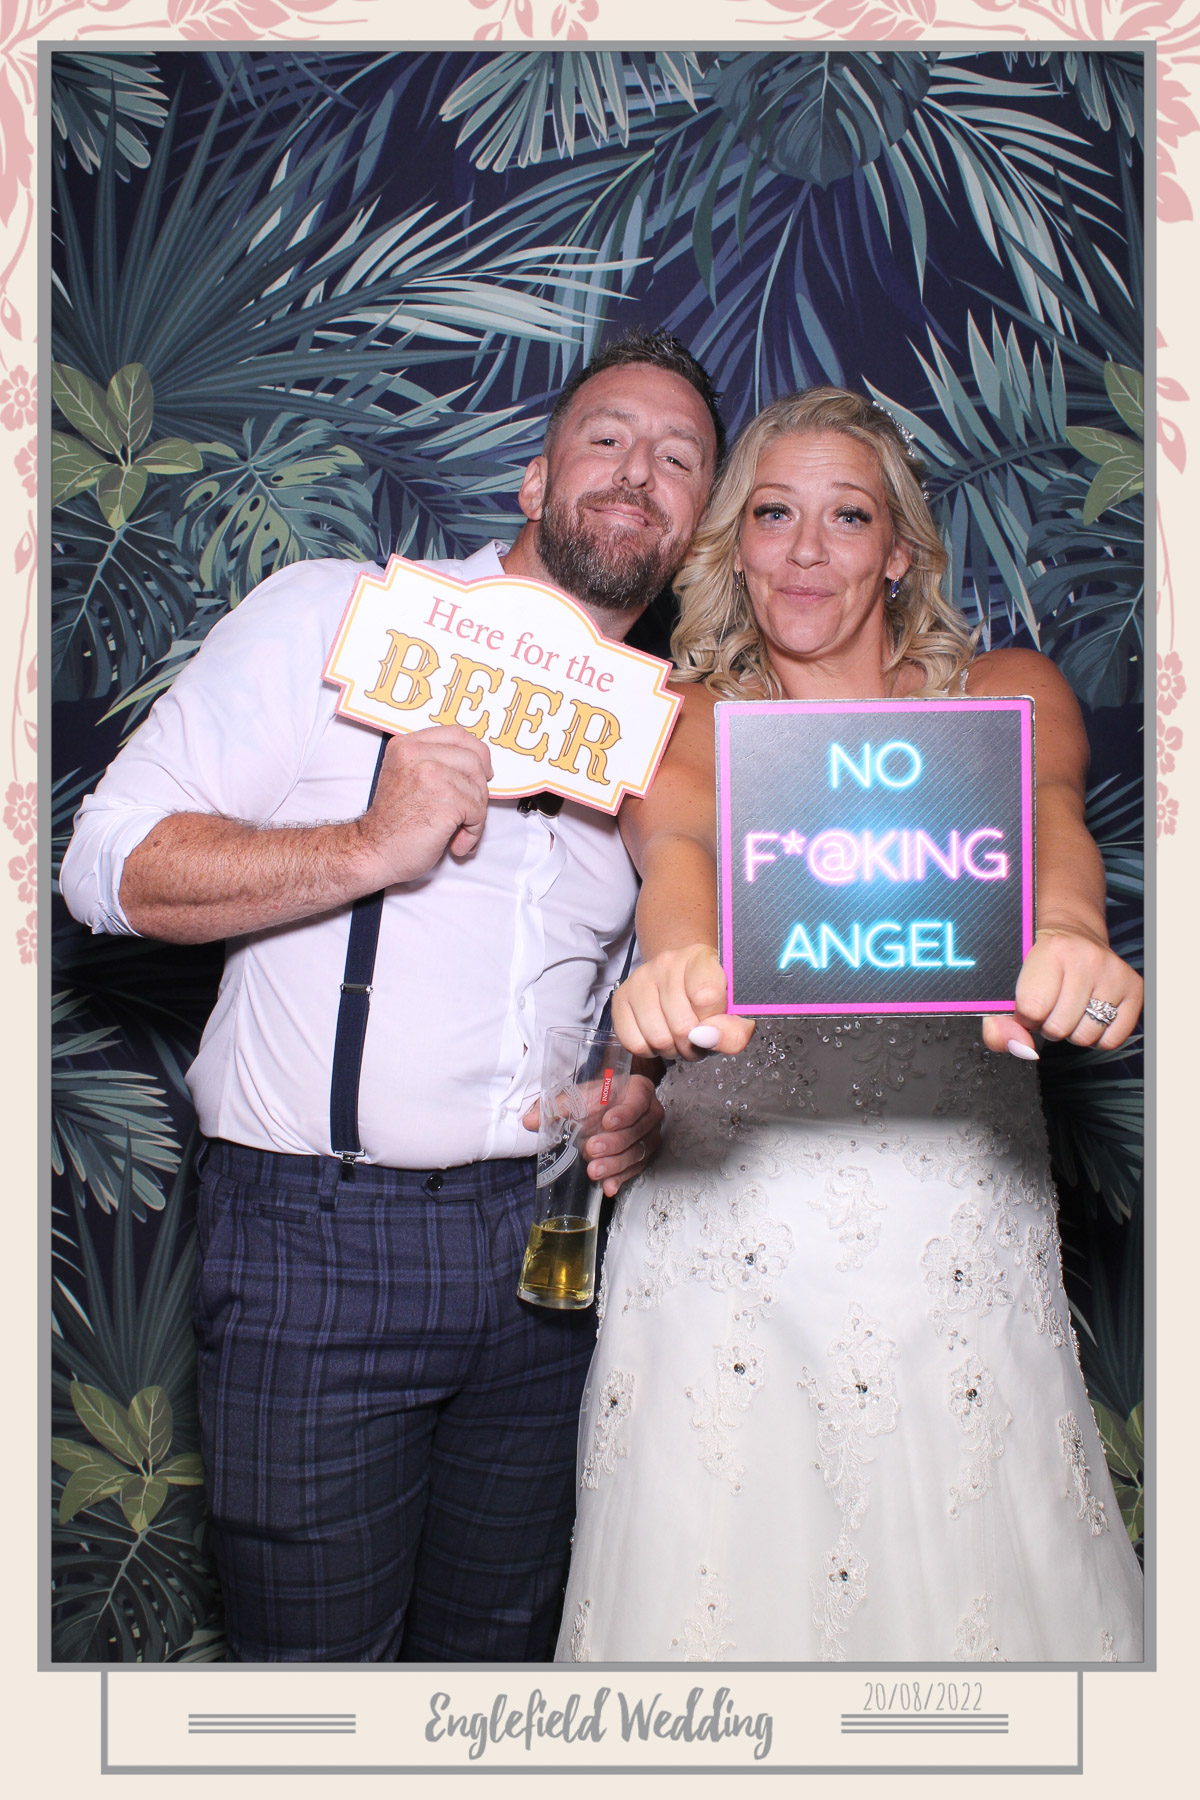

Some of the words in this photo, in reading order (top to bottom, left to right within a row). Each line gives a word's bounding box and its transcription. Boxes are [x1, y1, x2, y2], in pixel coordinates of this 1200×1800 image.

[424, 596, 505, 650] Here
[510, 631, 560, 672] for
[564, 655, 614, 692] the
[364, 629, 622, 786] BEER
[830, 740, 922, 788] NO
[779, 922, 976, 969] ANGEL
[602, 1078, 611, 1102] PERONI
